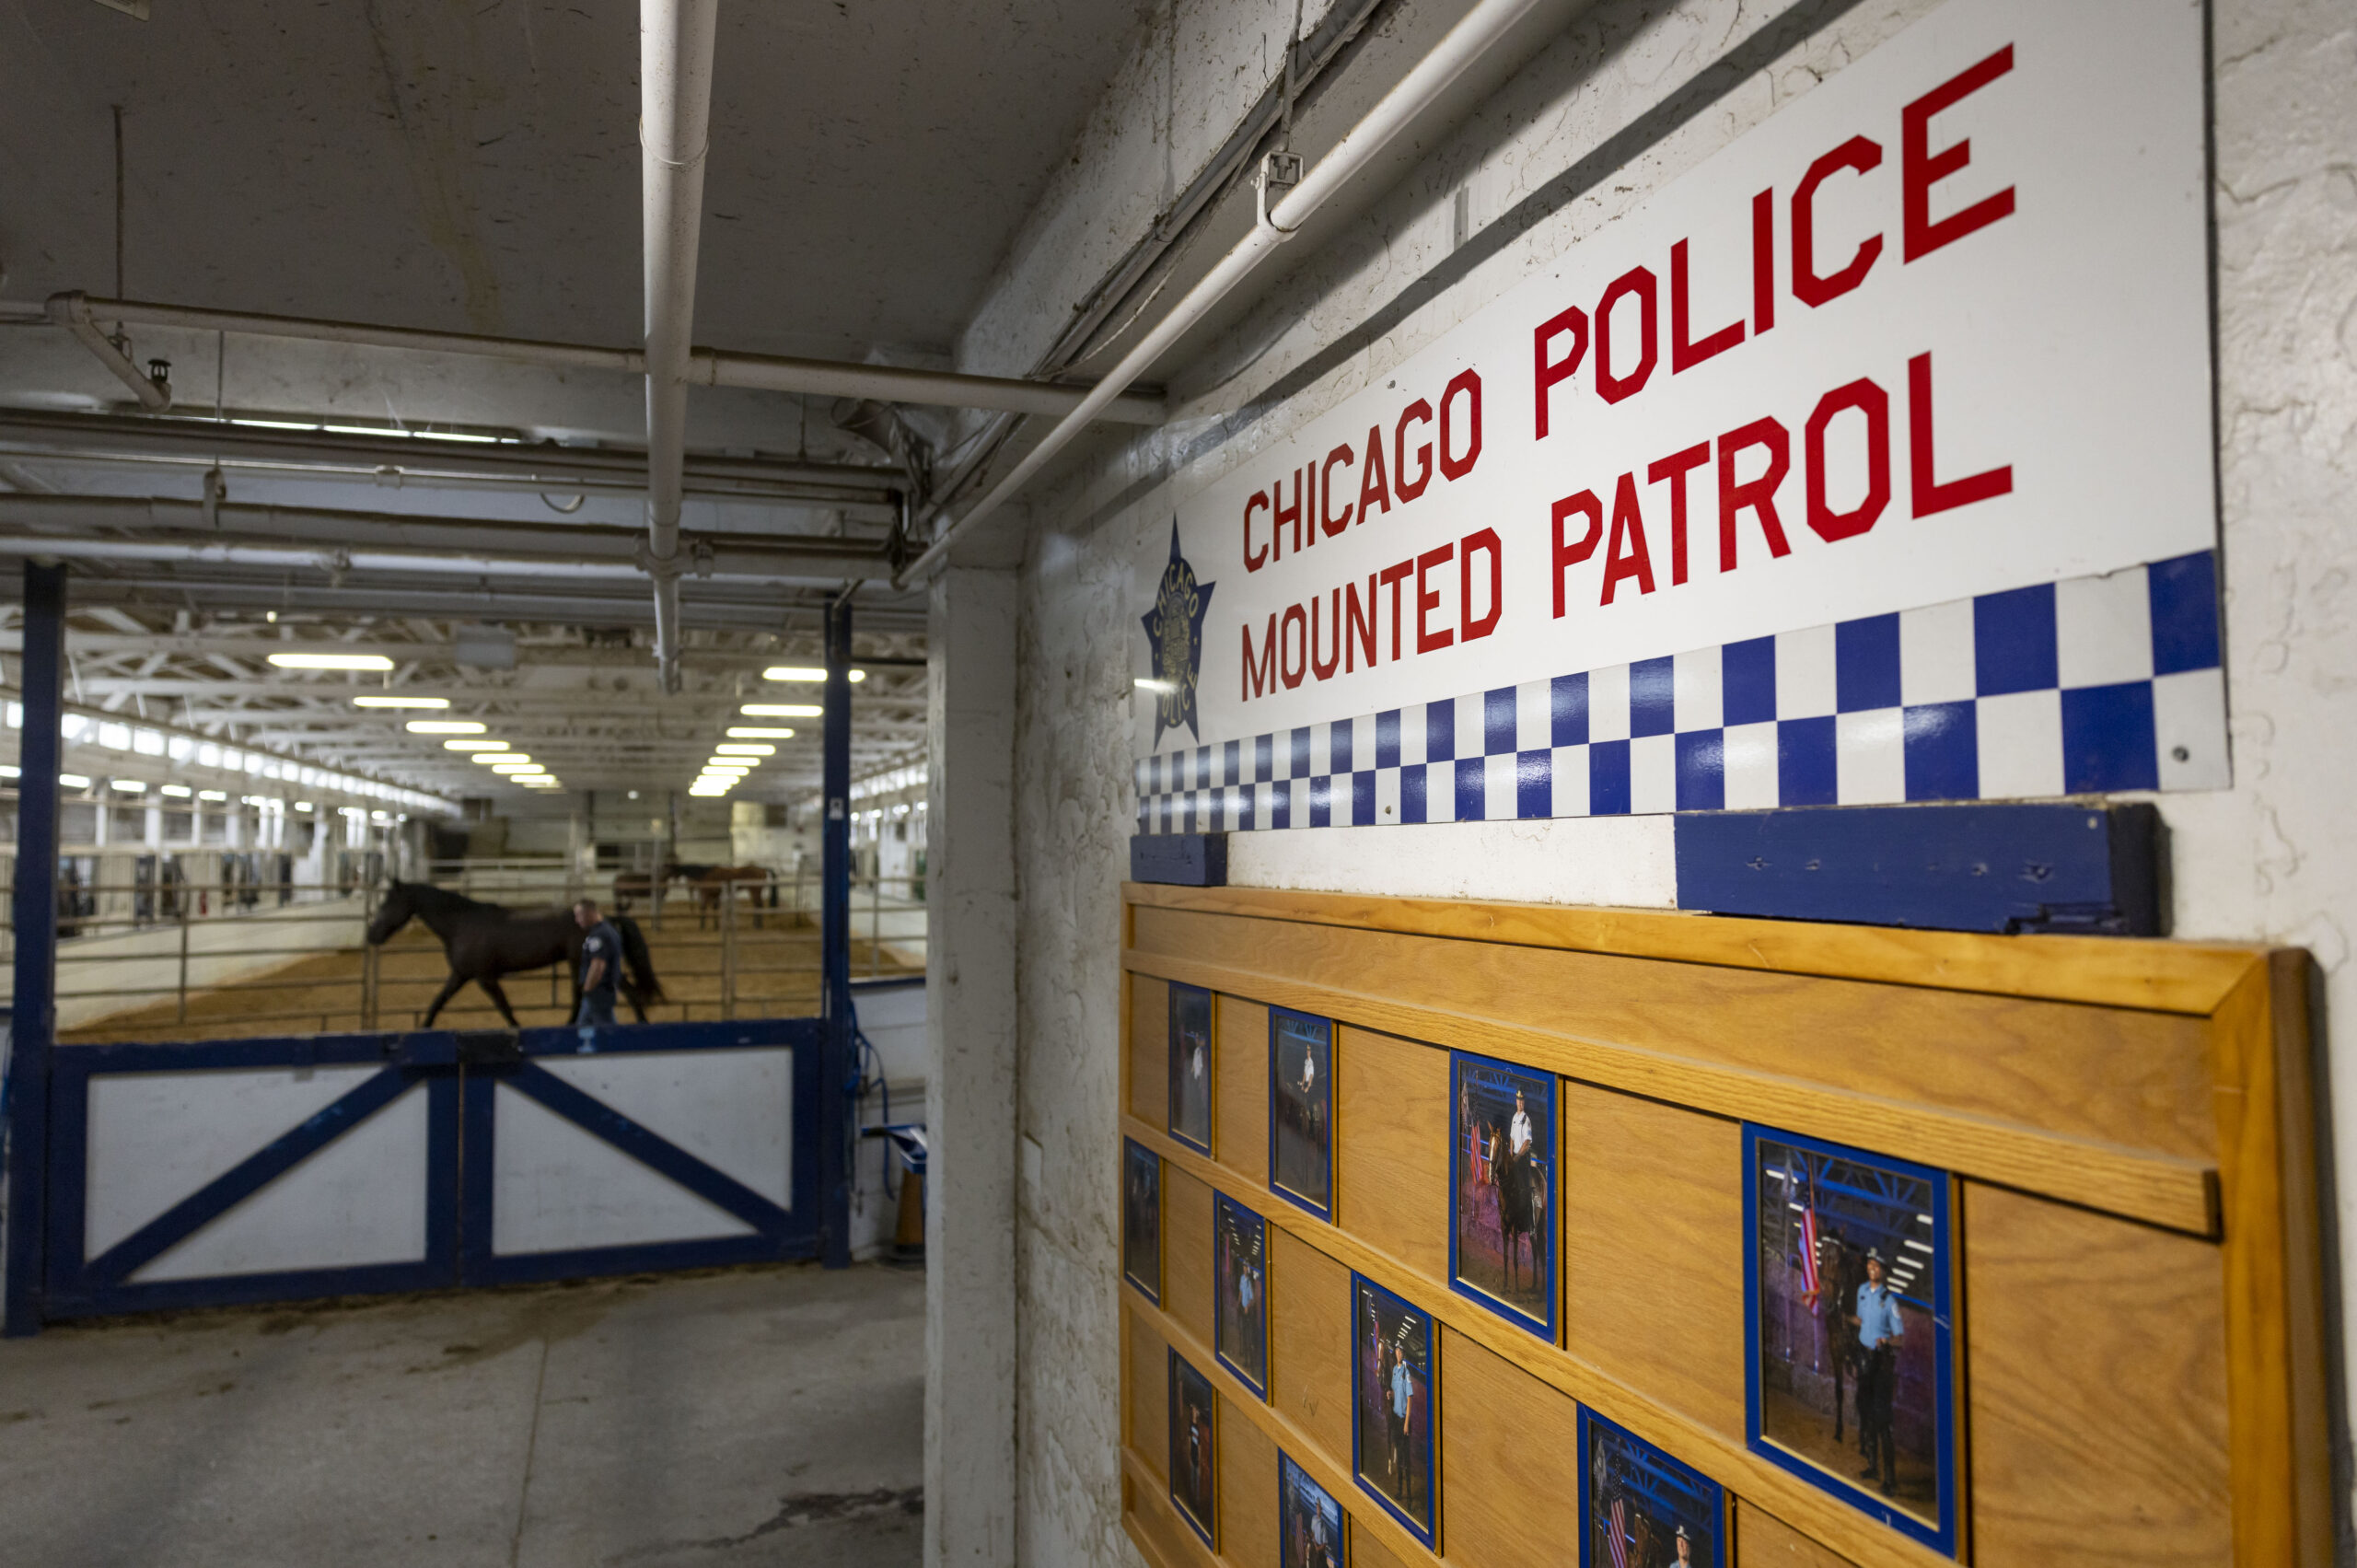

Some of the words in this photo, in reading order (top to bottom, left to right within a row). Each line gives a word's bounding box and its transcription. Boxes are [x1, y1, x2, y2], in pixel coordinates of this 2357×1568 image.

[1244, 367, 1482, 573] CHICAGO
[1533, 42, 2015, 442] POLICE
[1153, 562, 1199, 637] CHICAGO
[1241, 526, 1503, 703] MOUNTED
[1550, 350, 2014, 621] PATROL
[1158, 662, 1198, 726] OLICE
